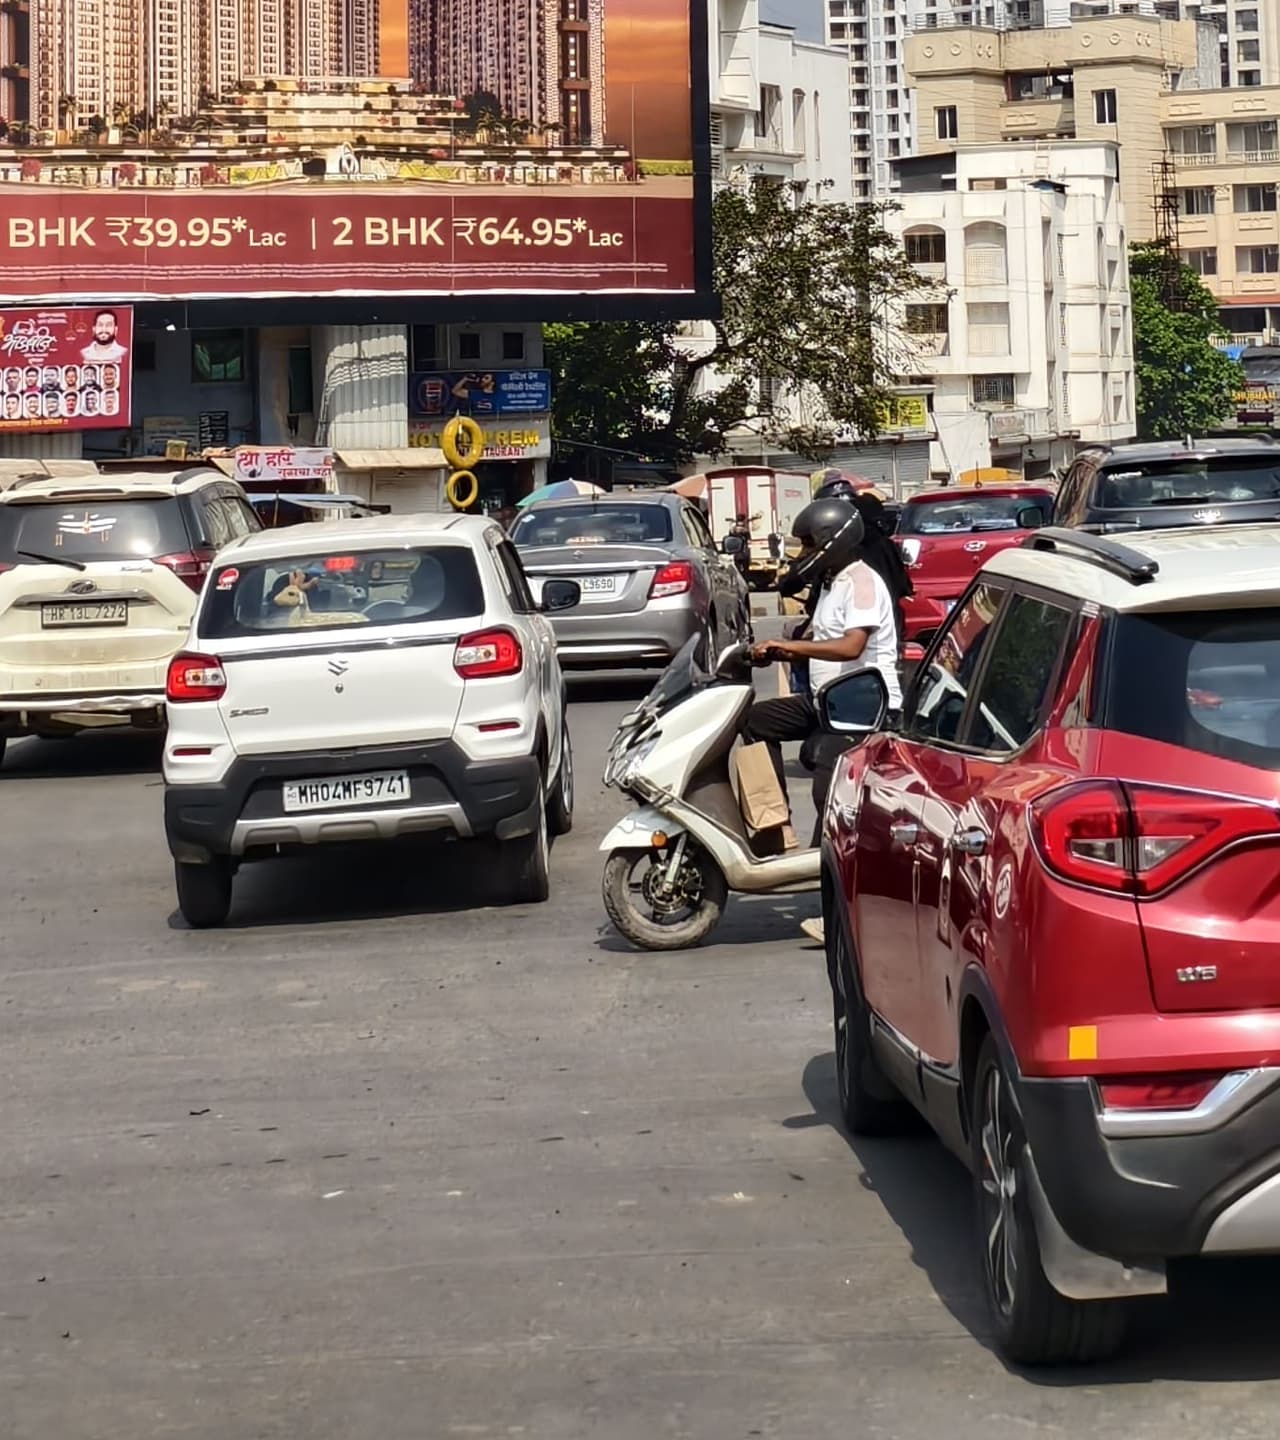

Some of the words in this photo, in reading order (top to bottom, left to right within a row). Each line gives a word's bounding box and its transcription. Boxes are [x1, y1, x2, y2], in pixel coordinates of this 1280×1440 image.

[8, 216, 96, 248] BHK
[249, 228, 287, 247] Lac
[331, 216, 354, 246] 2
[364, 216, 445, 247] BHK
[588, 228, 624, 247] Lac
[298, 774, 405, 804] MH04MF9741
